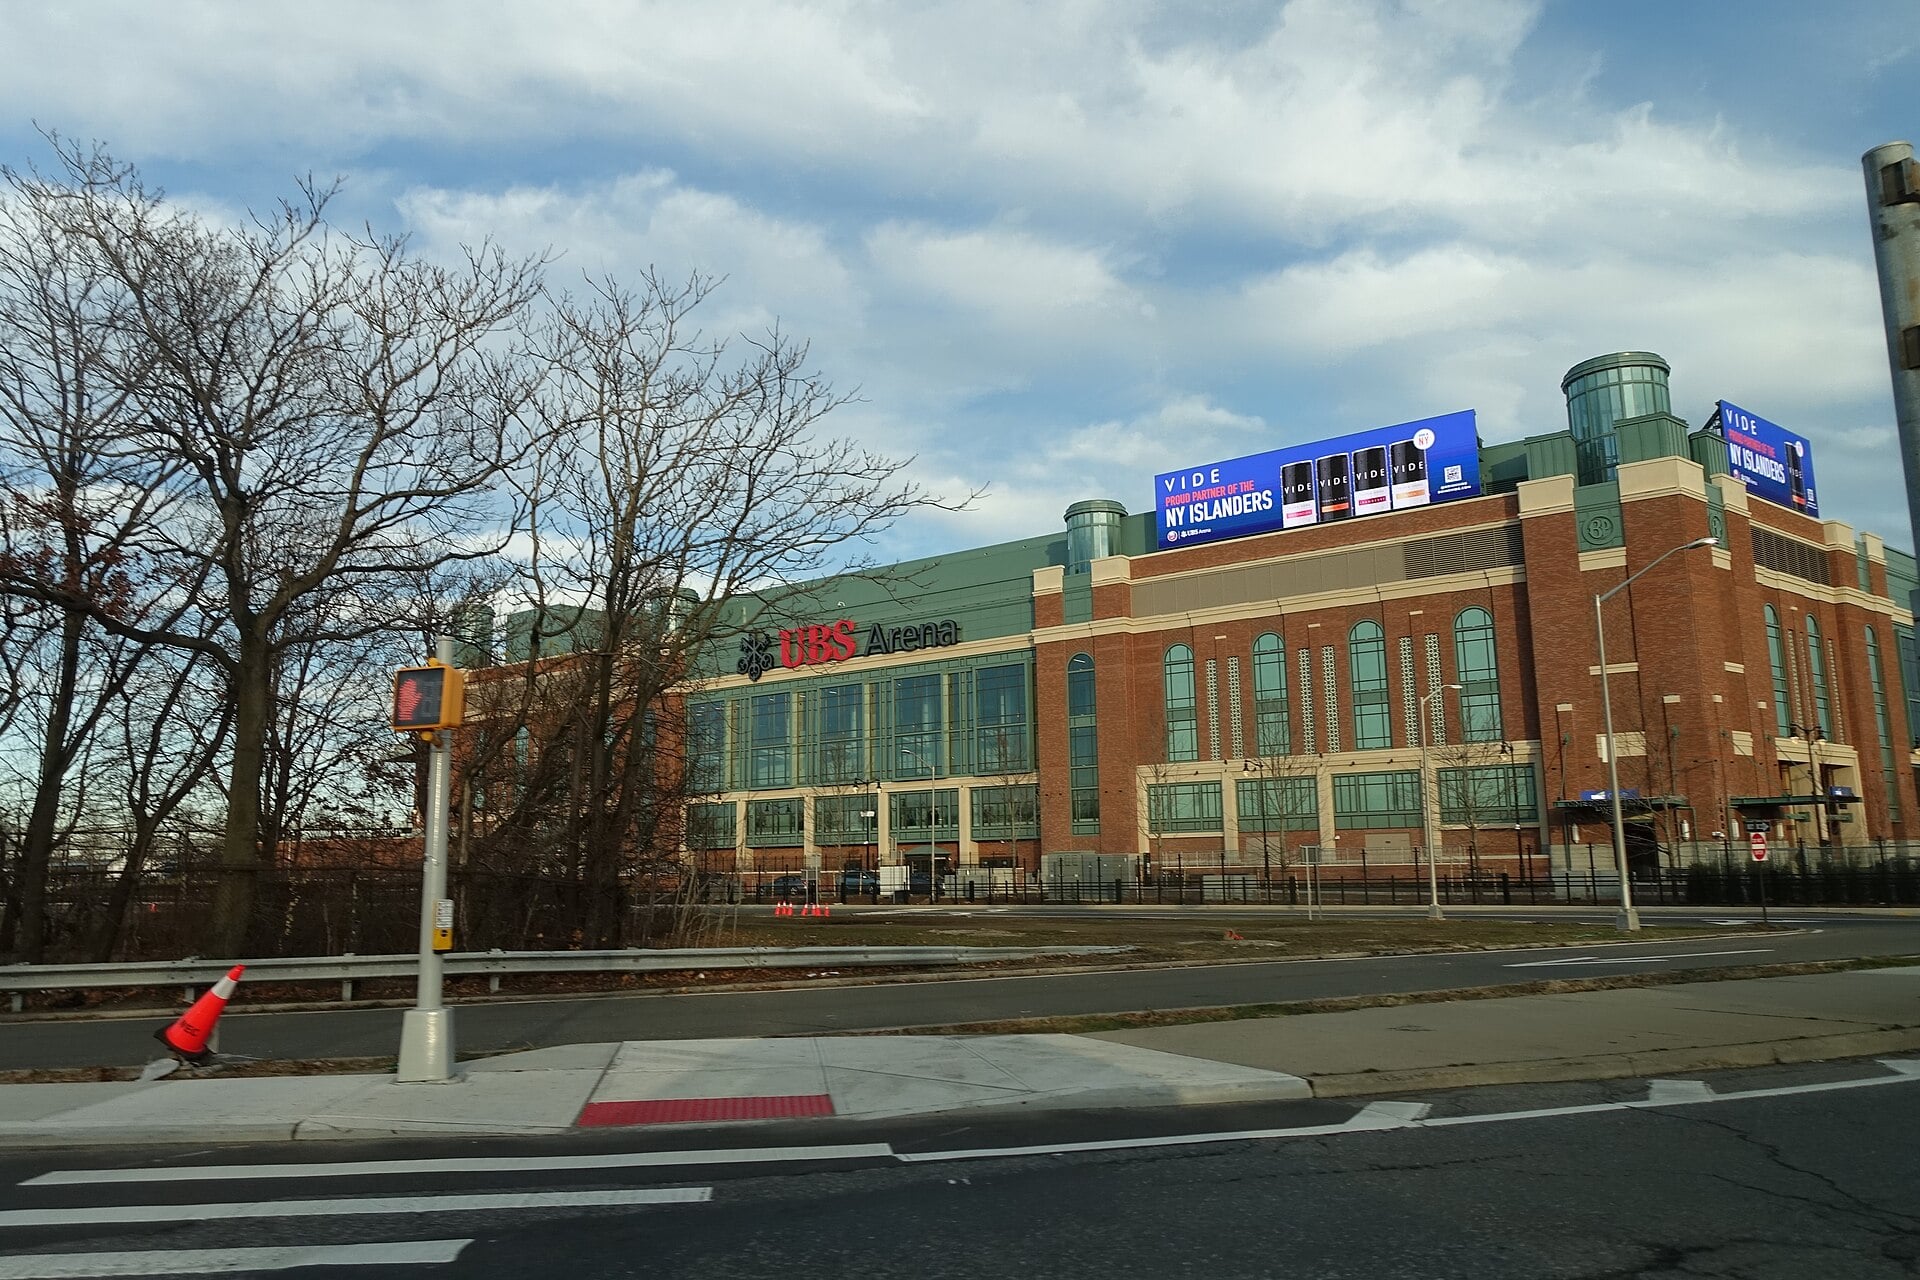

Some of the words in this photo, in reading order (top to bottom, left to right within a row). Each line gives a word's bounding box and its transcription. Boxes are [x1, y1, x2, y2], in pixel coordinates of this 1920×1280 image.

[1726, 409, 1758, 435] VIDE
[1356, 468, 1385, 481] VIDE
[1393, 461, 1424, 474] VIDE
[1742, 448, 1786, 483] ISLANDERS
[1164, 468, 1220, 492] VIDE
[1284, 482, 1312, 495] VIDE
[1319, 475, 1348, 488] VIDE
[1165, 493, 1190, 507] PROUD
[1192, 485, 1226, 502] PARTNER
[1227, 483, 1239, 495] OF
[1239, 480, 1255, 492] THE
[1165, 505, 1185, 528] NY
[1189, 489, 1273, 524] ISLANDERS
[778, 619, 857, 669] UBS
[863, 619, 960, 657] Arena
